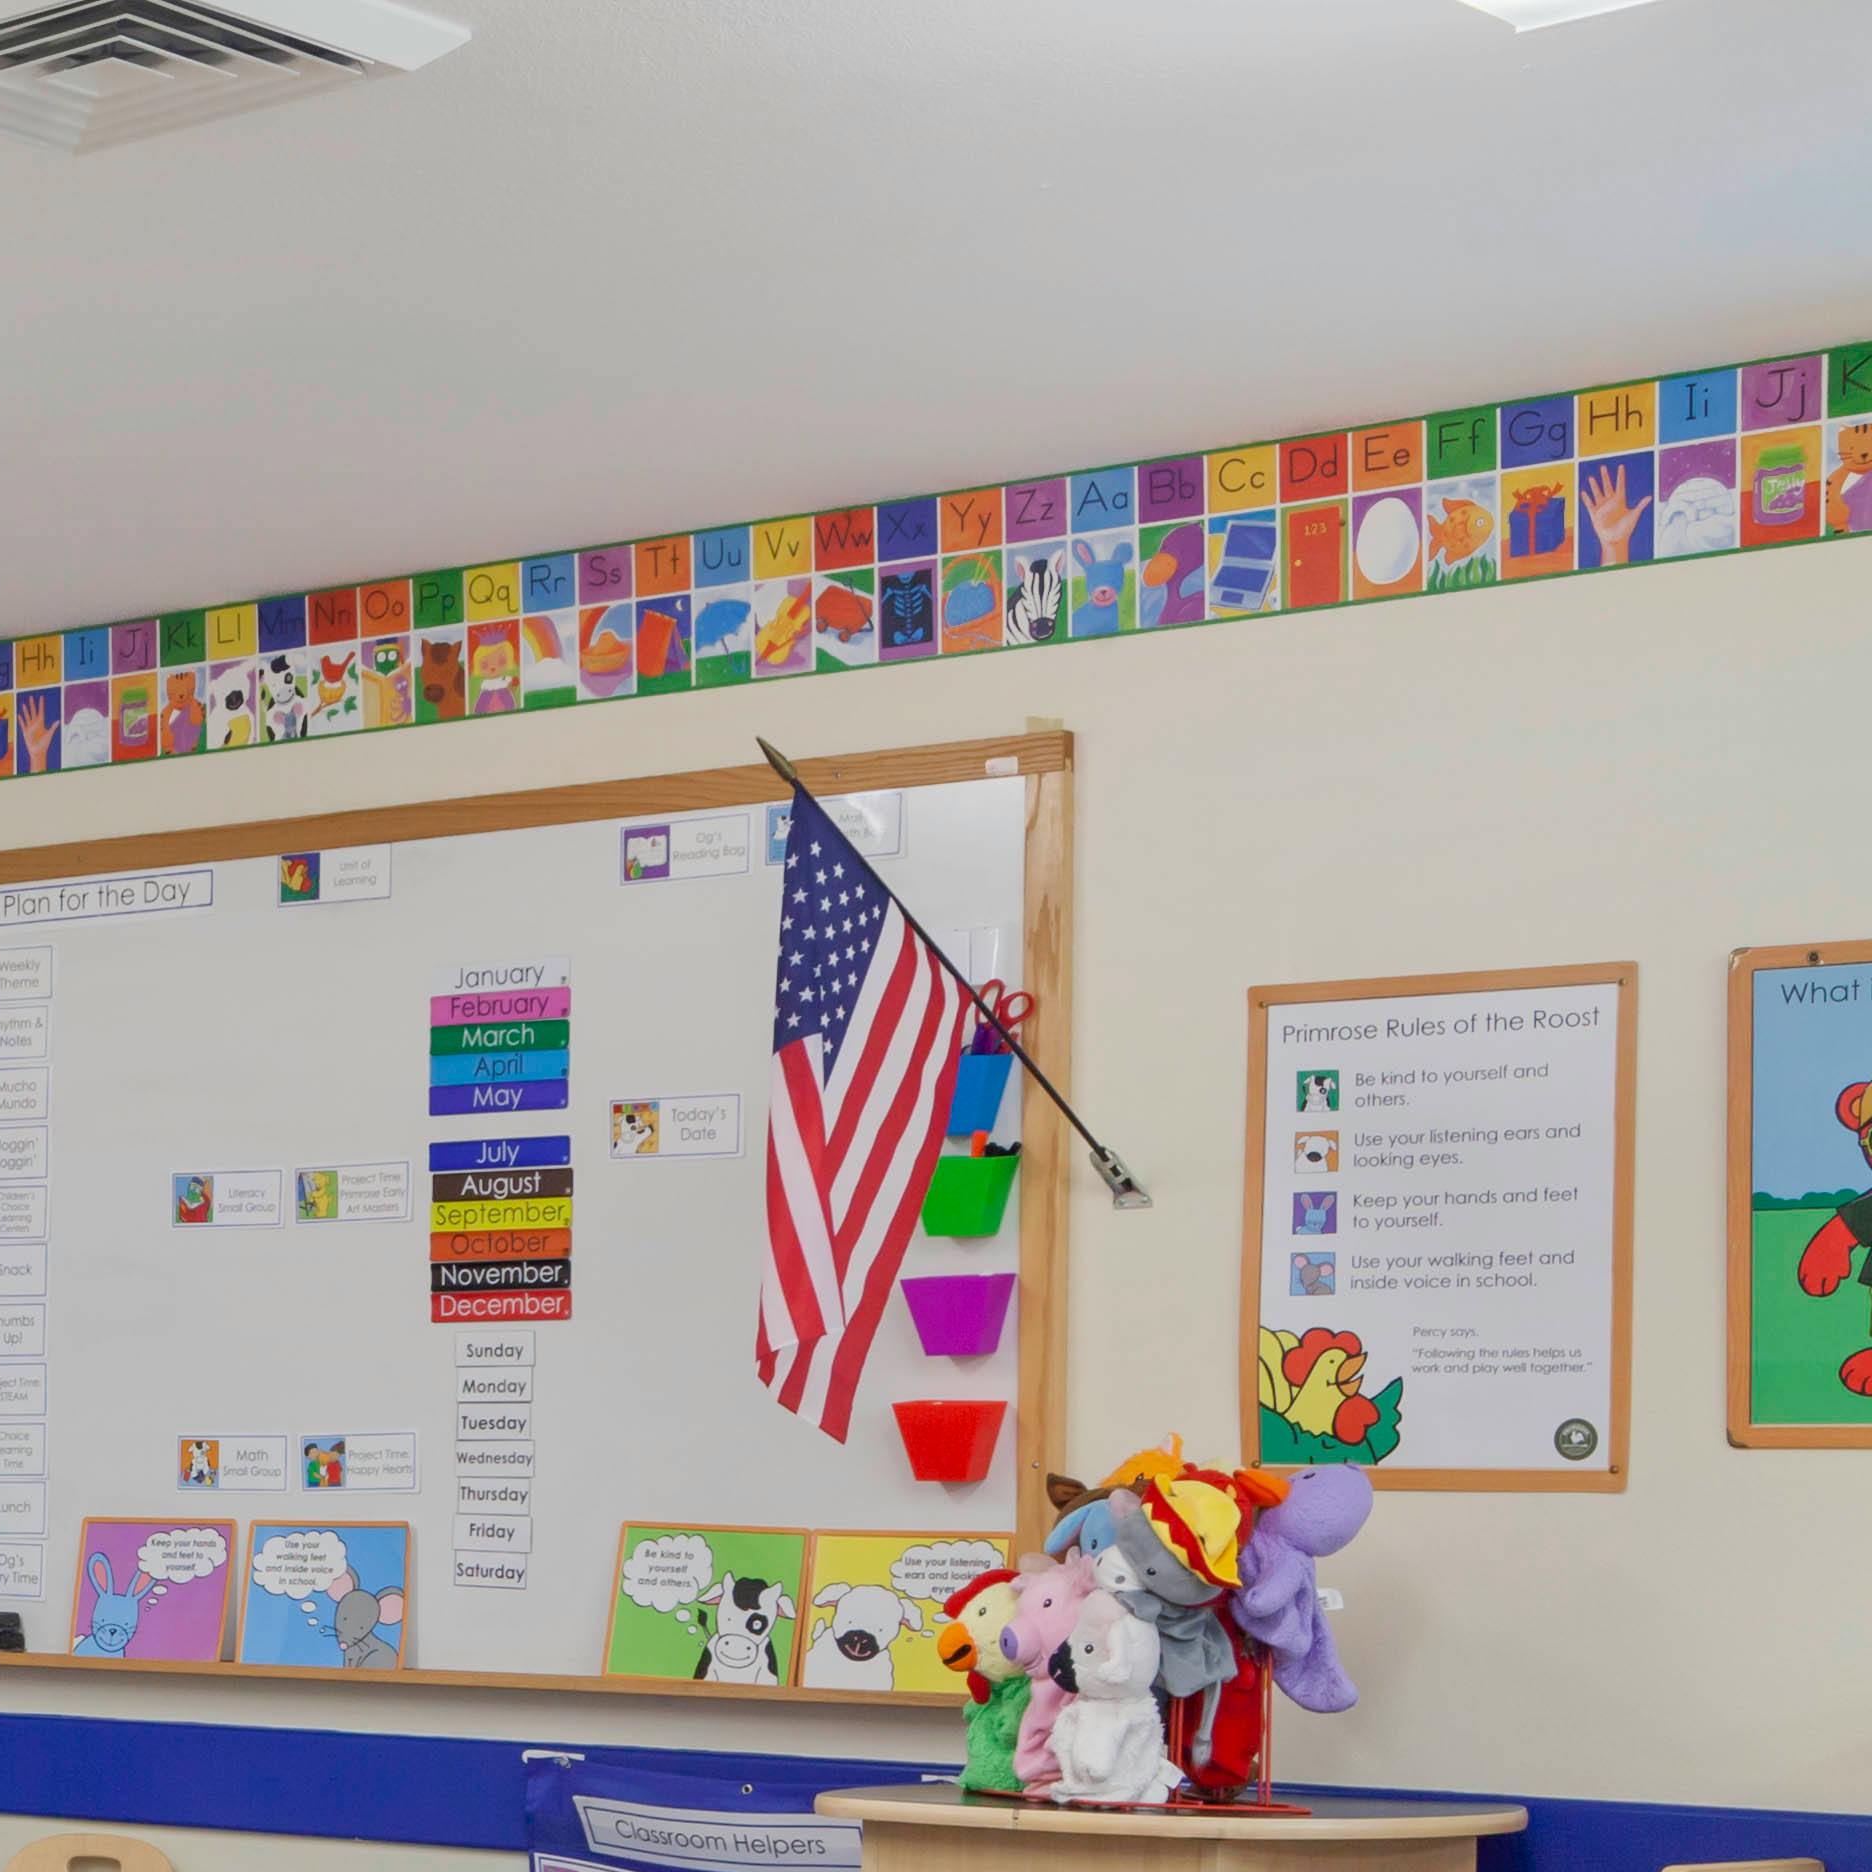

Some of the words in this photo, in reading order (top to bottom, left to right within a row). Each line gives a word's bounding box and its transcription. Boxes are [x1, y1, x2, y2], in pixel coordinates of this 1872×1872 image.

[1764, 473, 1806, 496] Jelly
[22, 643, 54, 674] Hh
[530, 564, 566, 596] Rr
[702, 538, 741, 570] Uu
[948, 506, 992, 551] Yy
[1077, 481, 1128, 516] Aa
[1218, 458, 1264, 492] Cc
[1364, 434, 1410, 472] Ee
[1509, 410, 1566, 457] Gg
[1686, 383, 1708, 420] Ii
[1756, 368, 1806, 422] Jj
[1302, 521, 1328, 538] 123
[4, 894, 50, 917] Plan
[59, 888, 88, 912] for
[98, 884, 135, 908] the
[143, 880, 191, 908] Day
[0, 976, 39, 990] Theme
[454, 966, 544, 989] January
[1781, 979, 1860, 1004] What
[450, 993, 549, 1018] February
[36, 1017, 43, 1028] &
[1283, 1024, 1378, 1044] Primrose
[1387, 1018, 1445, 1038] Rules
[1454, 1014, 1476, 1034] of
[1486, 1013, 1524, 1032] the
[1534, 1006, 1599, 1028] Roost
[0, 1036, 32, 1047] Notes
[461, 1024, 534, 1048] March
[472, 1054, 523, 1080] April
[1355, 1073, 1375, 1087] Be
[1382, 1070, 1415, 1084] kind
[1422, 1070, 1438, 1083] to
[1444, 1064, 1507, 1086] yourself
[1514, 1064, 1548, 1078] and
[473, 1086, 522, 1109] May
[1354, 1092, 1410, 1108] others.
[681, 1126, 717, 1140] Date
[1352, 1132, 1382, 1147] Use
[1389, 1134, 1424, 1148] your
[1430, 1130, 1498, 1144] listening
[1503, 1128, 1542, 1142] ears
[1546, 1124, 1580, 1138] and
[476, 1141, 519, 1166] July
[1354, 1154, 1414, 1169] looking
[1419, 1152, 1464, 1168] eyes.
[461, 1172, 541, 1199] August
[1354, 1195, 1397, 1210] Keep
[1403, 1195, 1440, 1209] your
[1445, 1190, 1497, 1204] hands
[1503, 1188, 1537, 1203] and
[1544, 1187, 1578, 1202] feet
[435, 1202, 565, 1229] September
[1353, 1216, 1369, 1228] to
[1374, 1212, 1443, 1230] yourself.
[450, 1234, 549, 1257] October
[1351, 1256, 1381, 1270] Use
[1386, 1256, 1422, 1270] your
[1428, 1253, 1493, 1269] walking
[1499, 1252, 1532, 1265] feet
[1539, 1250, 1574, 1264] and
[442, 1260, 562, 1285] November
[1350, 1275, 1400, 1289] inside
[1404, 1274, 1451, 1288] voice
[1456, 1273, 1470, 1288] in
[1476, 1272, 1536, 1287] school.
[440, 1294, 564, 1319] December
[467, 1344, 523, 1360] Sunday
[463, 1380, 526, 1396] Monday
[462, 1416, 526, 1432] Tuesday
[236, 1450, 268, 1461] Math
[457, 1450, 533, 1468] Wednesday
[224, 1466, 247, 1477] Small
[250, 1466, 281, 1478] Group
[461, 1486, 528, 1504] Thursday
[470, 1523, 514, 1542] Friday
[8, 1572, 38, 1584] Time
[457, 1563, 525, 1583] Saturday
[614, 1818, 728, 1854] Classroom
[733, 1834, 826, 1858] Helpers
